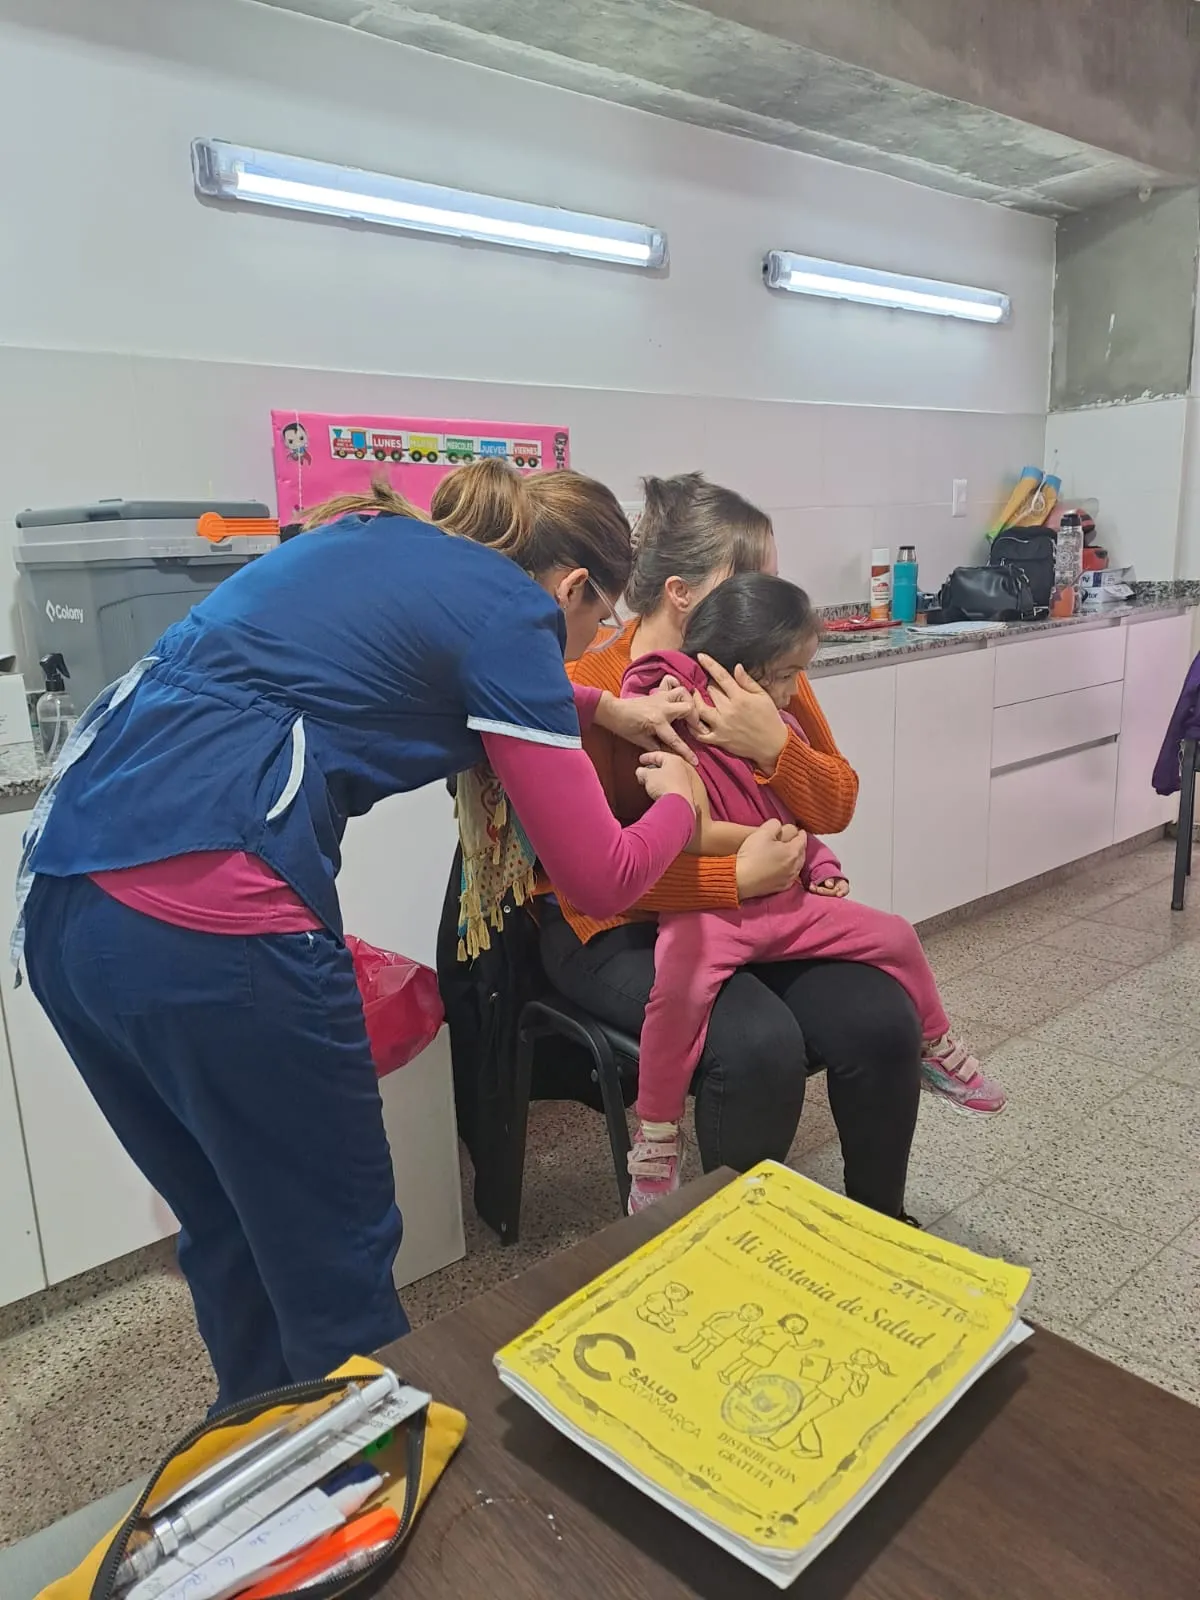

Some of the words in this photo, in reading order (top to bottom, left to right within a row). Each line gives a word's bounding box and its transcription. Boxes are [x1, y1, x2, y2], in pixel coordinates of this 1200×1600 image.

[373, 437, 402, 448] LUNES
[480, 444, 506, 454] JUEVES
[55, 604, 84, 624] Colony
[726, 1231, 764, 1255] Mi
[757, 1249, 837, 1301] Historia
[836, 1297, 864, 1316] de
[863, 1308, 937, 1349] Salud
[628, 1367, 678, 1404] SALUD
[618, 1375, 702, 1439] CATAMARCA
[698, 1464, 723, 1483] AÑO
[717, 1432, 798, 1484] DISTRIBUCIÓN
[718, 1450, 775, 1488] GRATUITA
